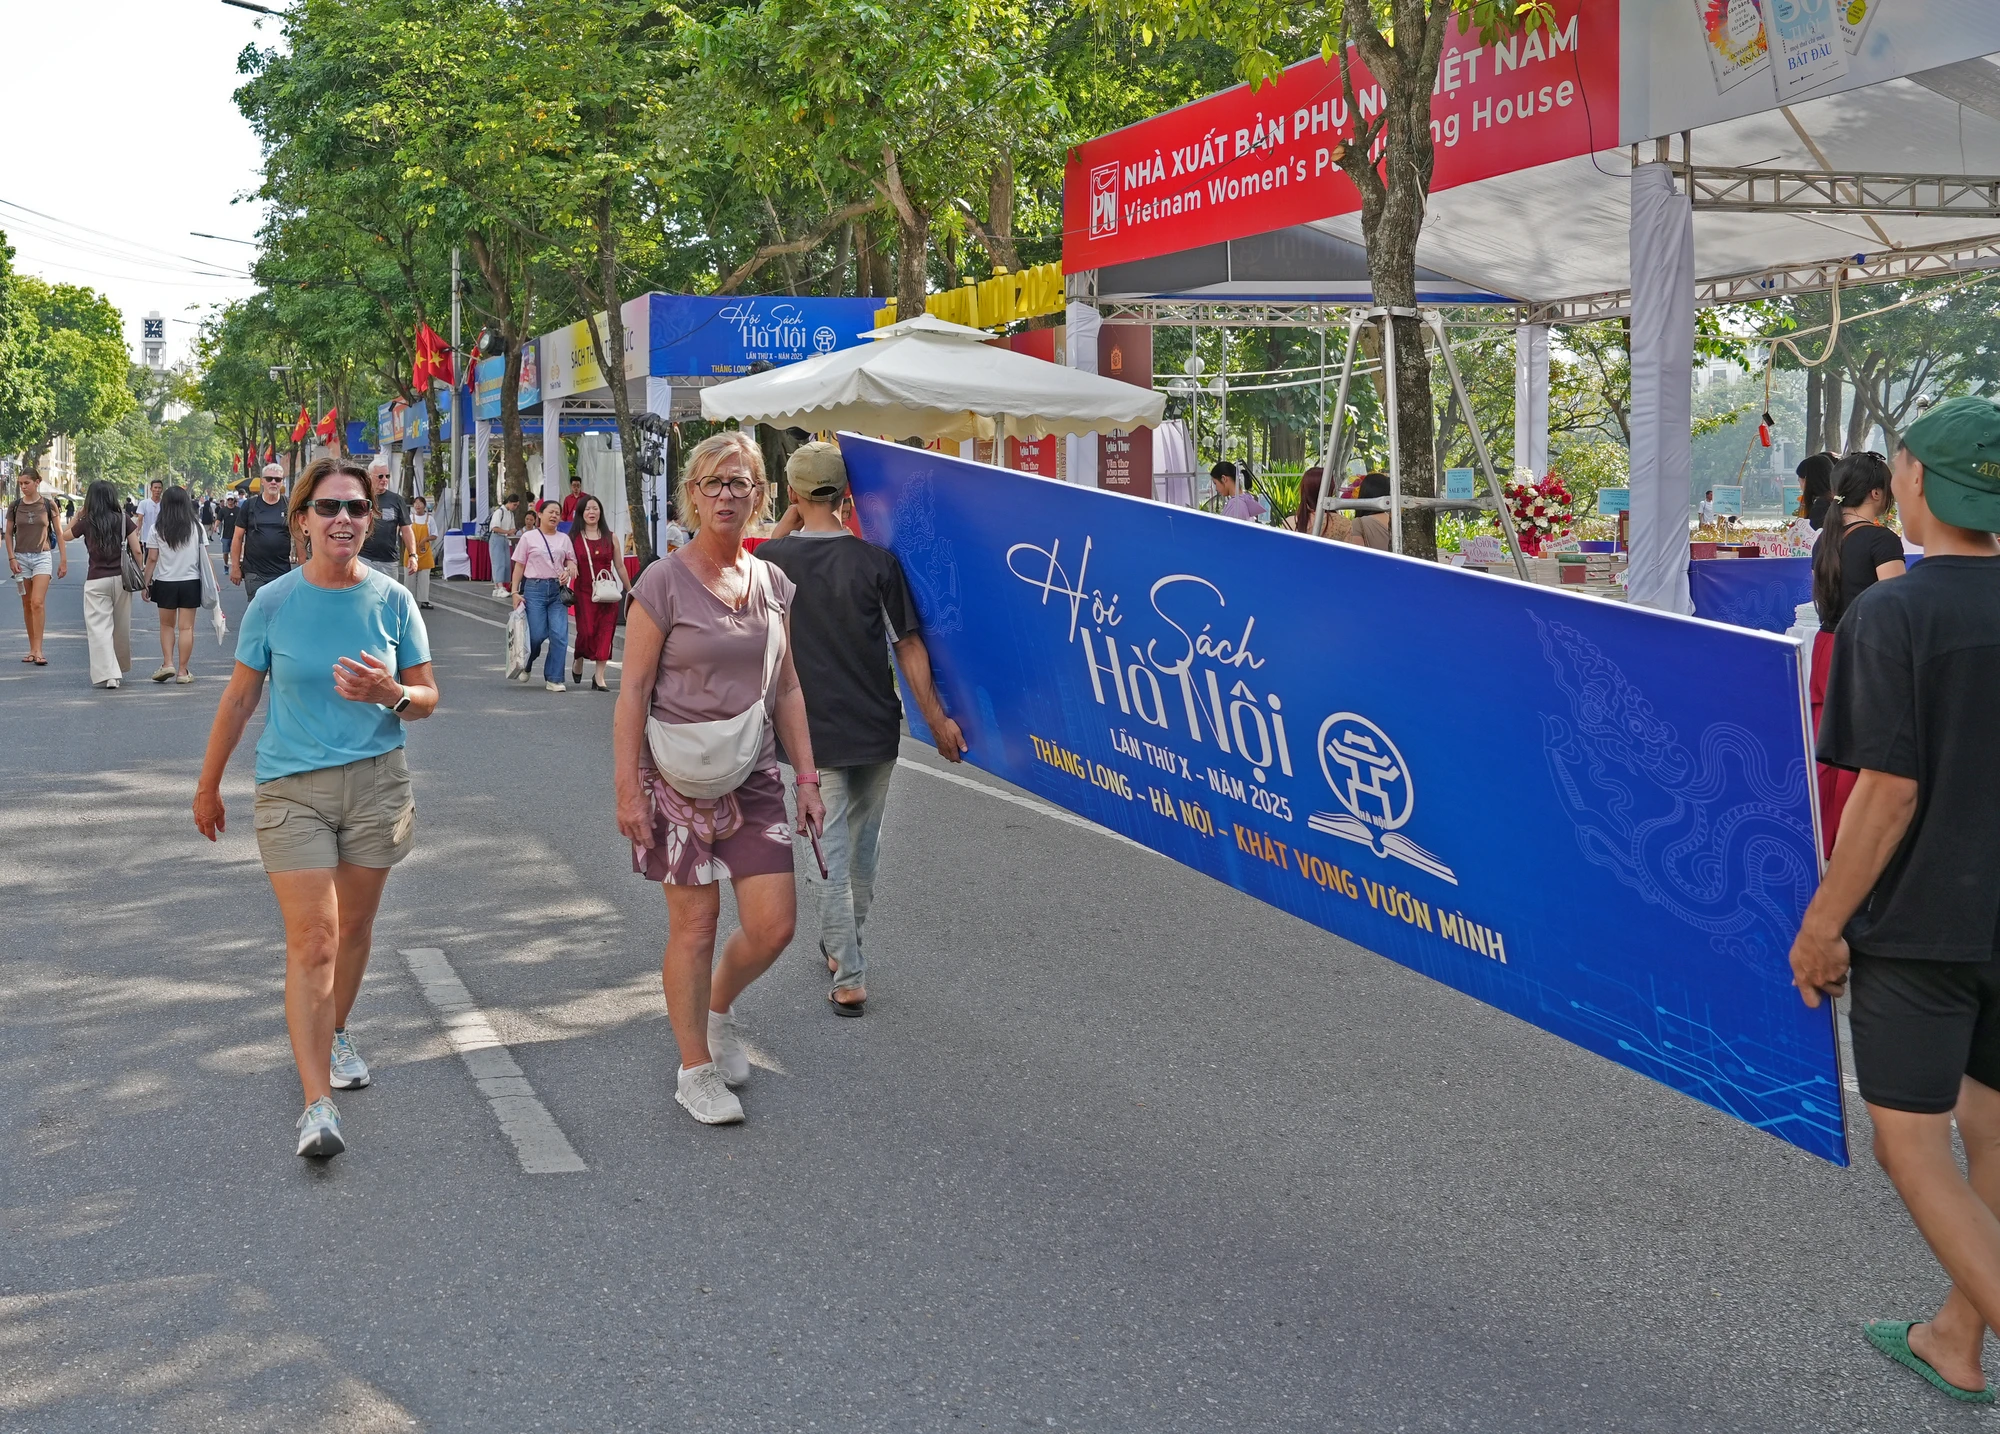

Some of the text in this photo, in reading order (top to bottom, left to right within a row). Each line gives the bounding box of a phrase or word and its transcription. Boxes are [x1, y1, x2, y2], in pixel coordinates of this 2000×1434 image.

[1124, 149, 1166, 191] NHÀ
[1171, 128, 1228, 177] XUẤT
[1235, 112, 1285, 158] BẢN
[1294, 97, 1348, 140] PHỤ
[1432, 47, 1483, 100] IỆT
[1495, 15, 1578, 75] NAM
[1124, 189, 1201, 227] Vietnam
[1473, 80, 1574, 132] House
[718, 301, 803, 333] Hội Sách
[742, 325, 806, 353] Hà Nội
[1006, 535, 1265, 675] Hội Sách
[1080, 627, 1293, 784] Hà Nội
[1109, 728, 1142, 761] LẦN
[1142, 741, 1176, 774] THỨ
[1180, 755, 1193, 782] X
[1206, 767, 1248, 804] NĂM
[1249, 784, 1293, 823] 2025
[1030, 734, 1085, 780] THĂNG
[1087, 759, 1132, 801] LONG
[1148, 786, 1179, 822] HÀ
[1179, 799, 1215, 839] NỘI
[1233, 822, 1288, 870] KHÁT
[1293, 848, 1358, 900] VỌNG
[1361, 876, 1433, 933] VƯƠN
[1437, 908, 1507, 965] MÌNH
